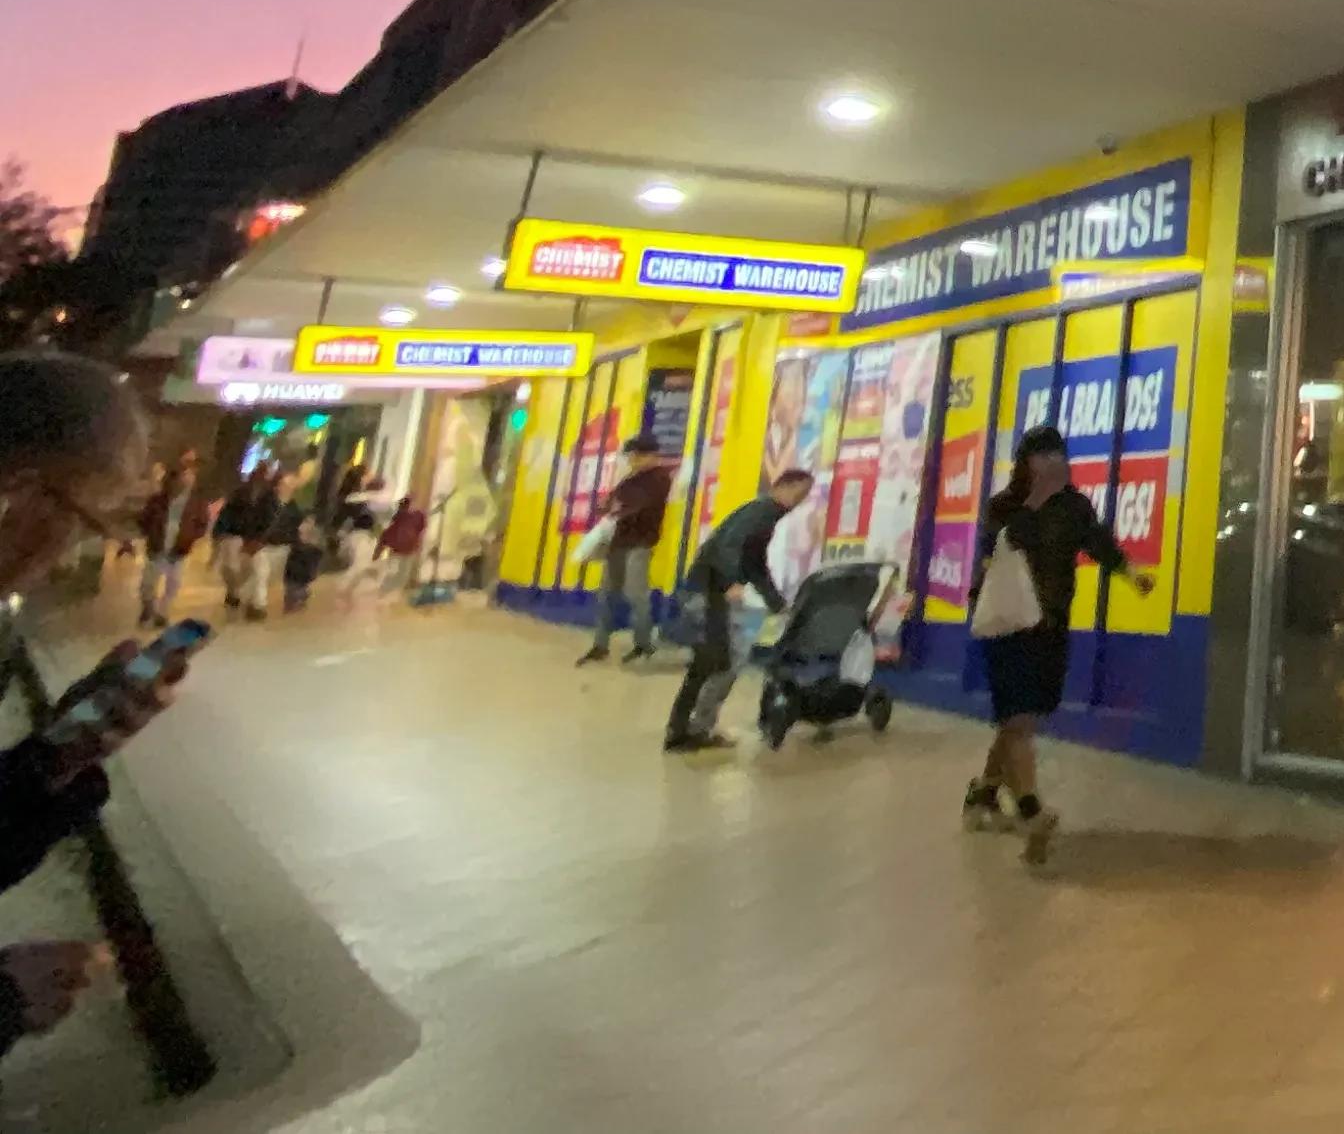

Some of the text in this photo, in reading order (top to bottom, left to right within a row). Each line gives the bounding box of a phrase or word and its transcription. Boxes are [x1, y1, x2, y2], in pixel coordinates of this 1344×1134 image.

[968, 178, 1177, 290] WAREHOUSE
[646, 255, 842, 293] CHEMIST WAREHOUSE
[261, 382, 345, 401] HUAWEI
